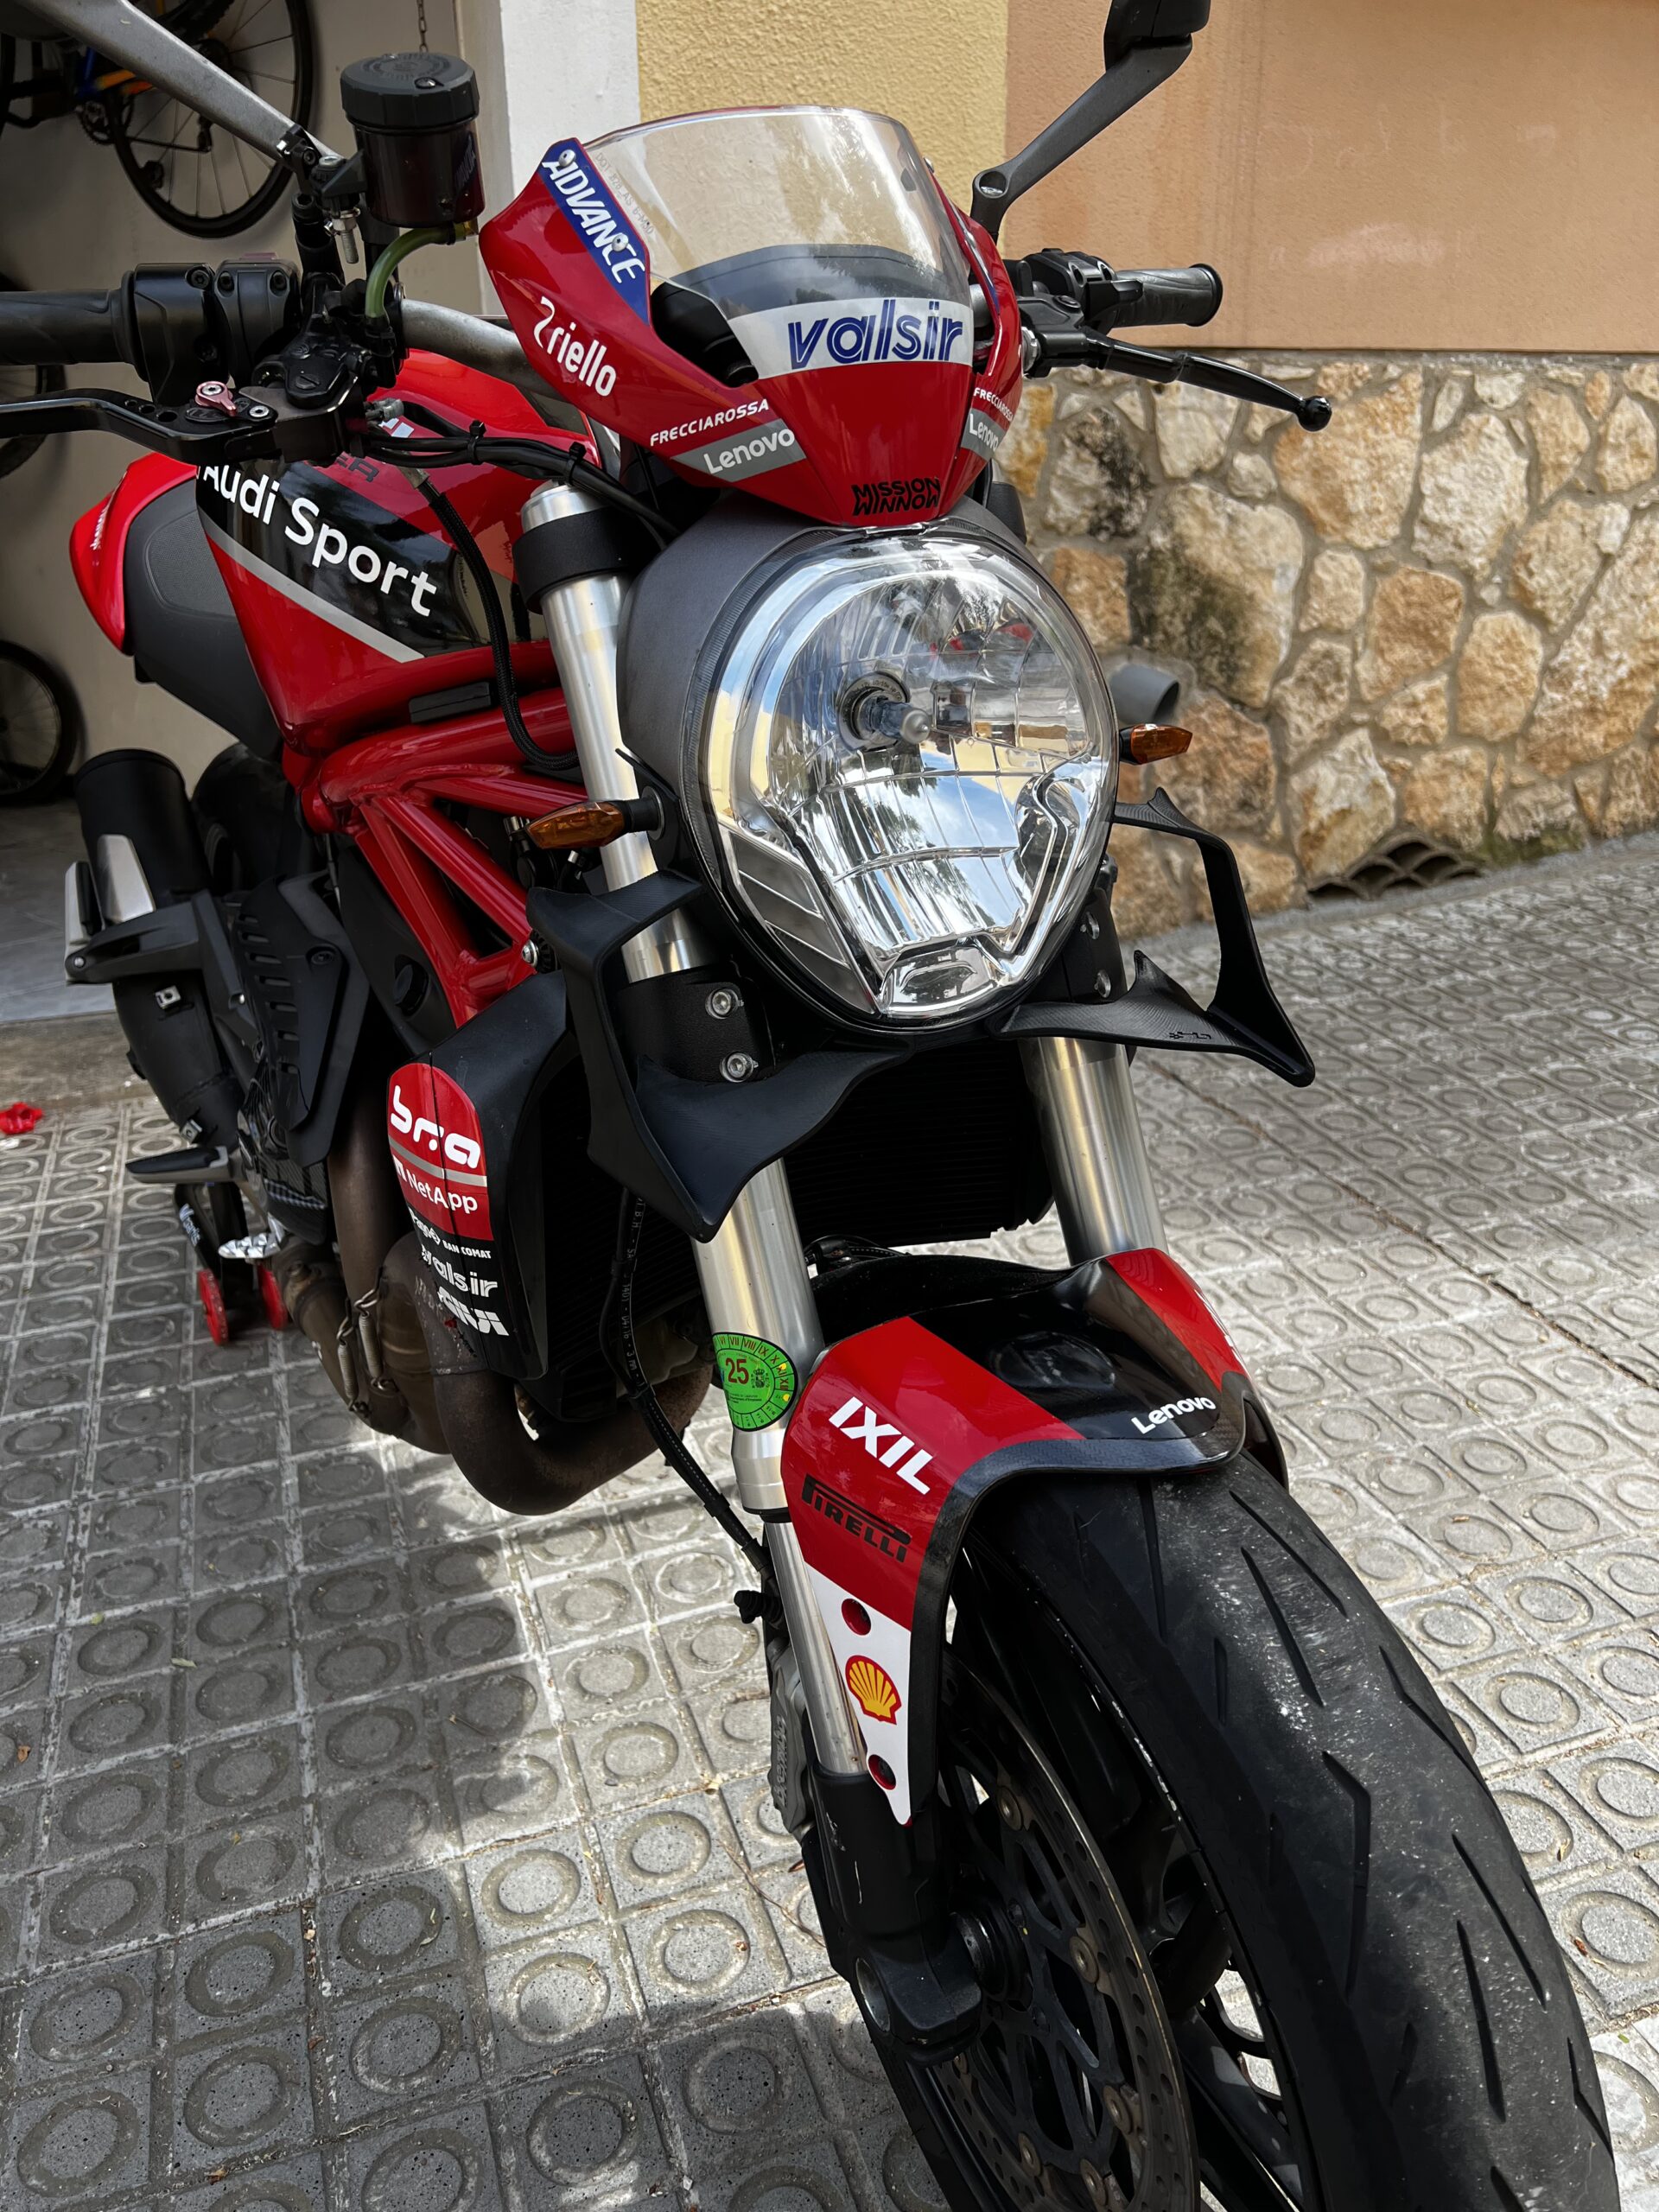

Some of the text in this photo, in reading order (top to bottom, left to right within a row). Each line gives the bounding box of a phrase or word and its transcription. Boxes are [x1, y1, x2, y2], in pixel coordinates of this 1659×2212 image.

[542, 162, 645, 283] ADVANCE
[788, 299, 963, 370] valsir
[547, 321, 617, 397] riello
[650, 398, 770, 448] FRECCIAROSSA
[973, 387, 1014, 423] FRECCIAROSSA
[702, 429, 795, 475] Lenovo
[969, 413, 1000, 451] Lenovo
[851, 477, 941, 499] MISSION
[852, 493, 940, 517] WINNOW
[202, 464, 437, 617] Audi Sport
[406, 1168, 478, 1215] NetApp
[725, 1357, 749, 1384] 25
[728, 1337, 740, 1346] VII
[743, 1338, 757, 1351] VIII
[758, 1345, 770, 1357] IX
[771, 1354, 780, 1364] X
[779, 1377, 789, 1390] XII
[1131, 1396, 1217, 1434] Lenovo
[829, 1396, 933, 1495] IXIL
[801, 1472, 912, 1563] PIRELLI
